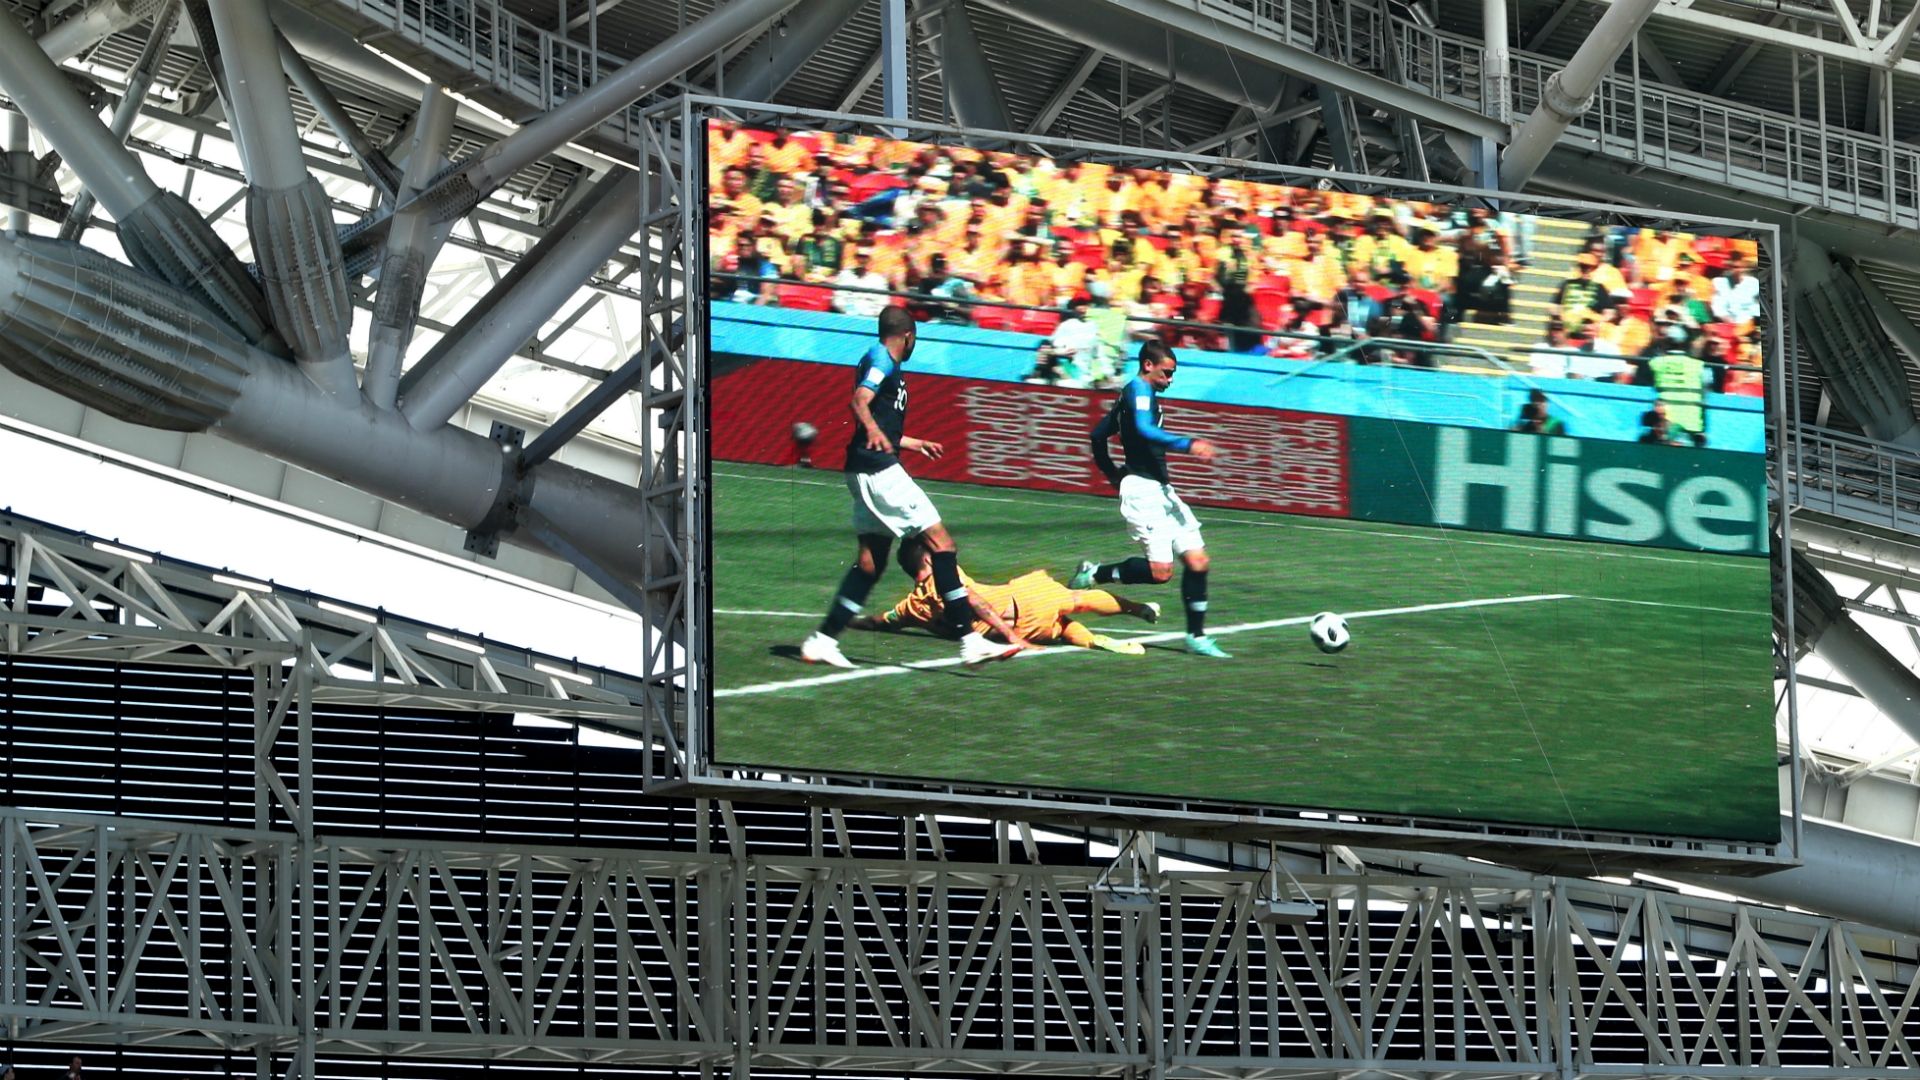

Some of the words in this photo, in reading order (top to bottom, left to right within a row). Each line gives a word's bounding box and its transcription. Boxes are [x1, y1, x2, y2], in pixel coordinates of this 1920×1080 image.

[954, 386, 1030, 480] ЗДОРОВЬЮ
[1027, 391, 1091, 486] ВАШЕМУ
[1432, 425, 1770, 553] Hise
